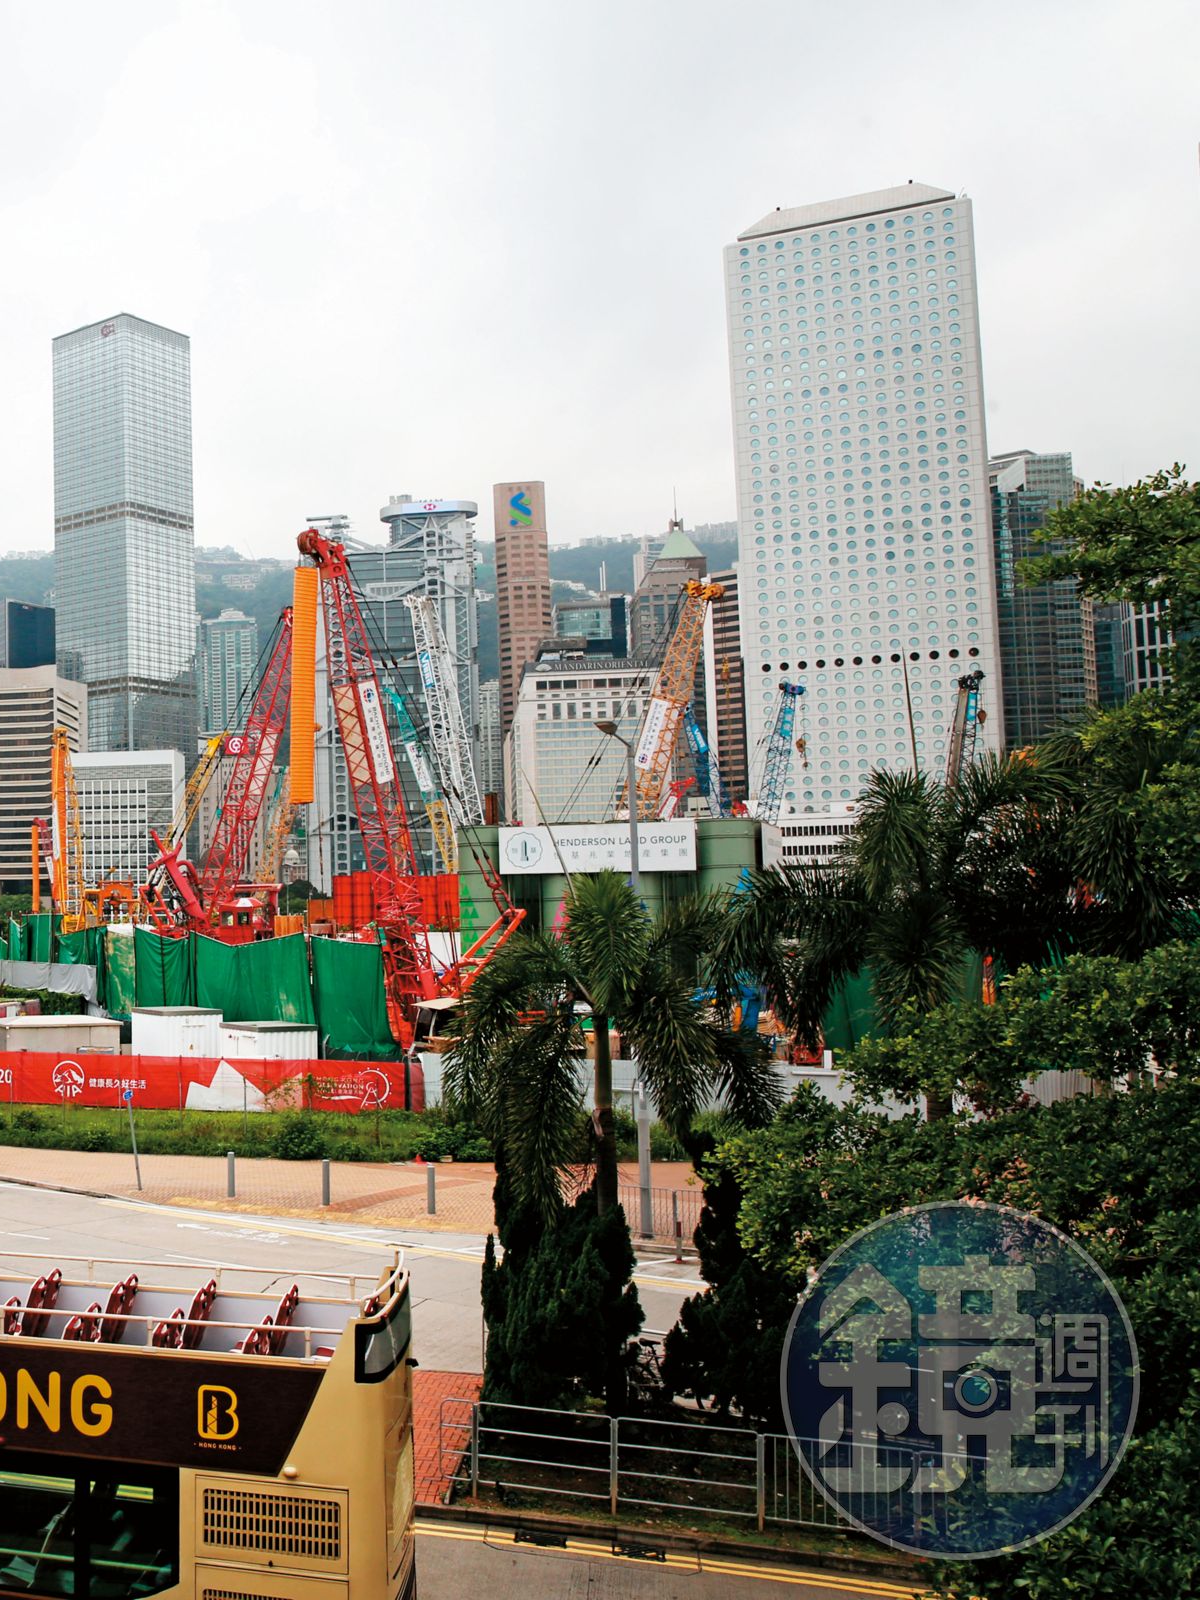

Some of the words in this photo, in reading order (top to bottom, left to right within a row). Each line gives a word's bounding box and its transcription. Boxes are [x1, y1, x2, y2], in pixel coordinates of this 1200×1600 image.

[554, 662, 603, 671] MANDARIN
[556, 837, 615, 847] HENDERSON
[619, 837, 647, 845] LAD
[651, 835, 687, 845] GROUP
[55, 1084, 83, 1098] AIA
